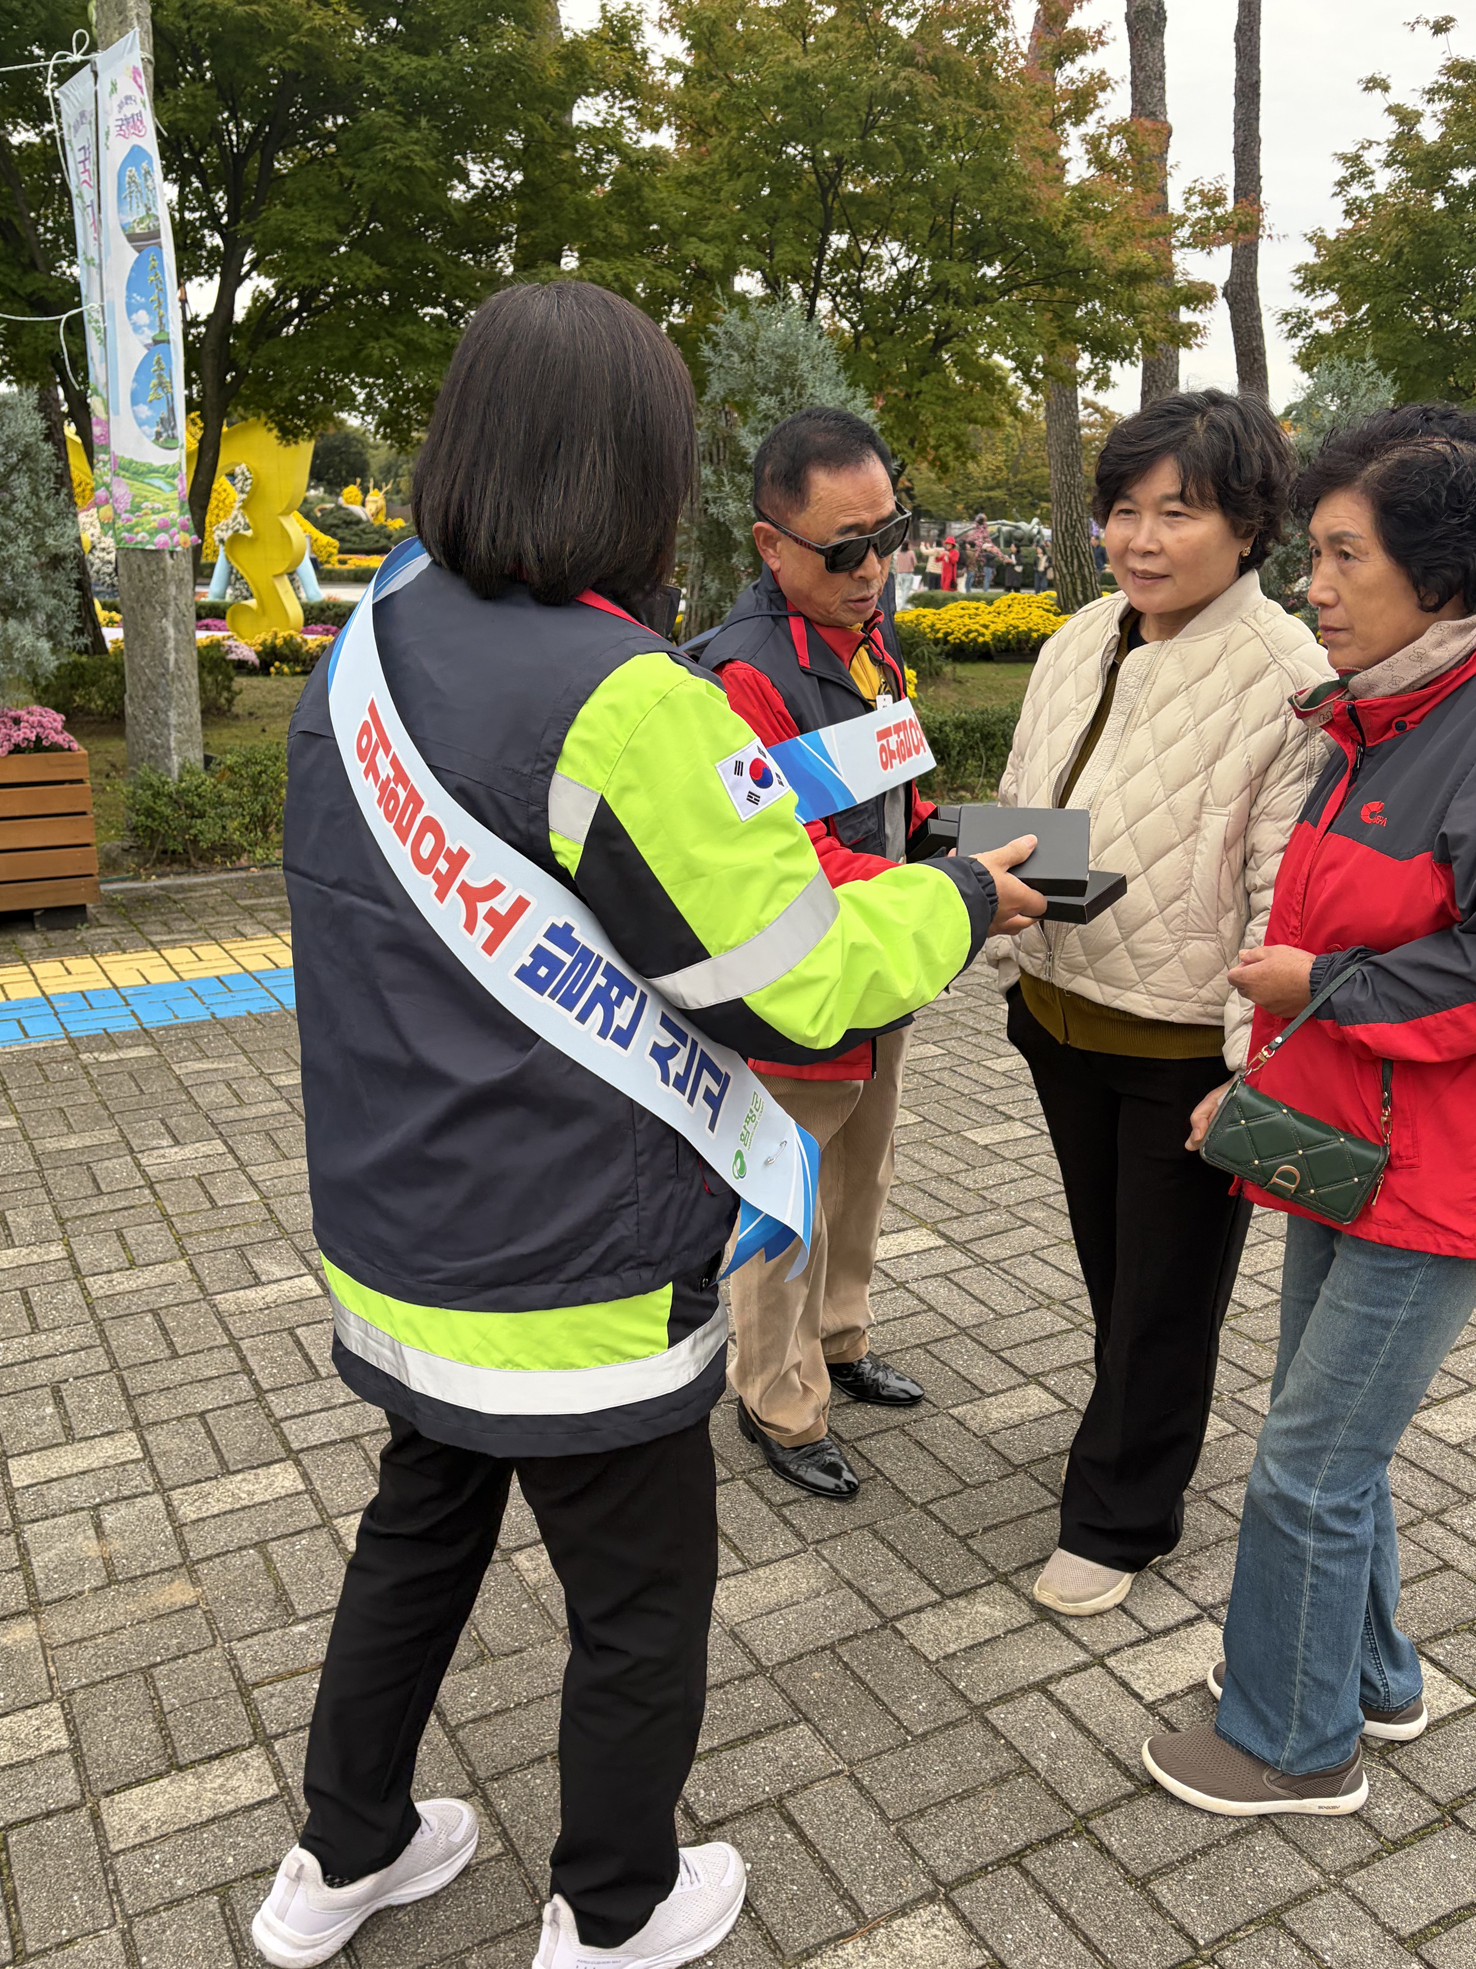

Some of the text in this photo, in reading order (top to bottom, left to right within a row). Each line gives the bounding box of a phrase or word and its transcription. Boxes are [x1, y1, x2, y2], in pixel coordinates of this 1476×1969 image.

[356, 697, 732, 1134] 위험요소 발견 신고
[740, 1091, 762, 1147] 함평군
